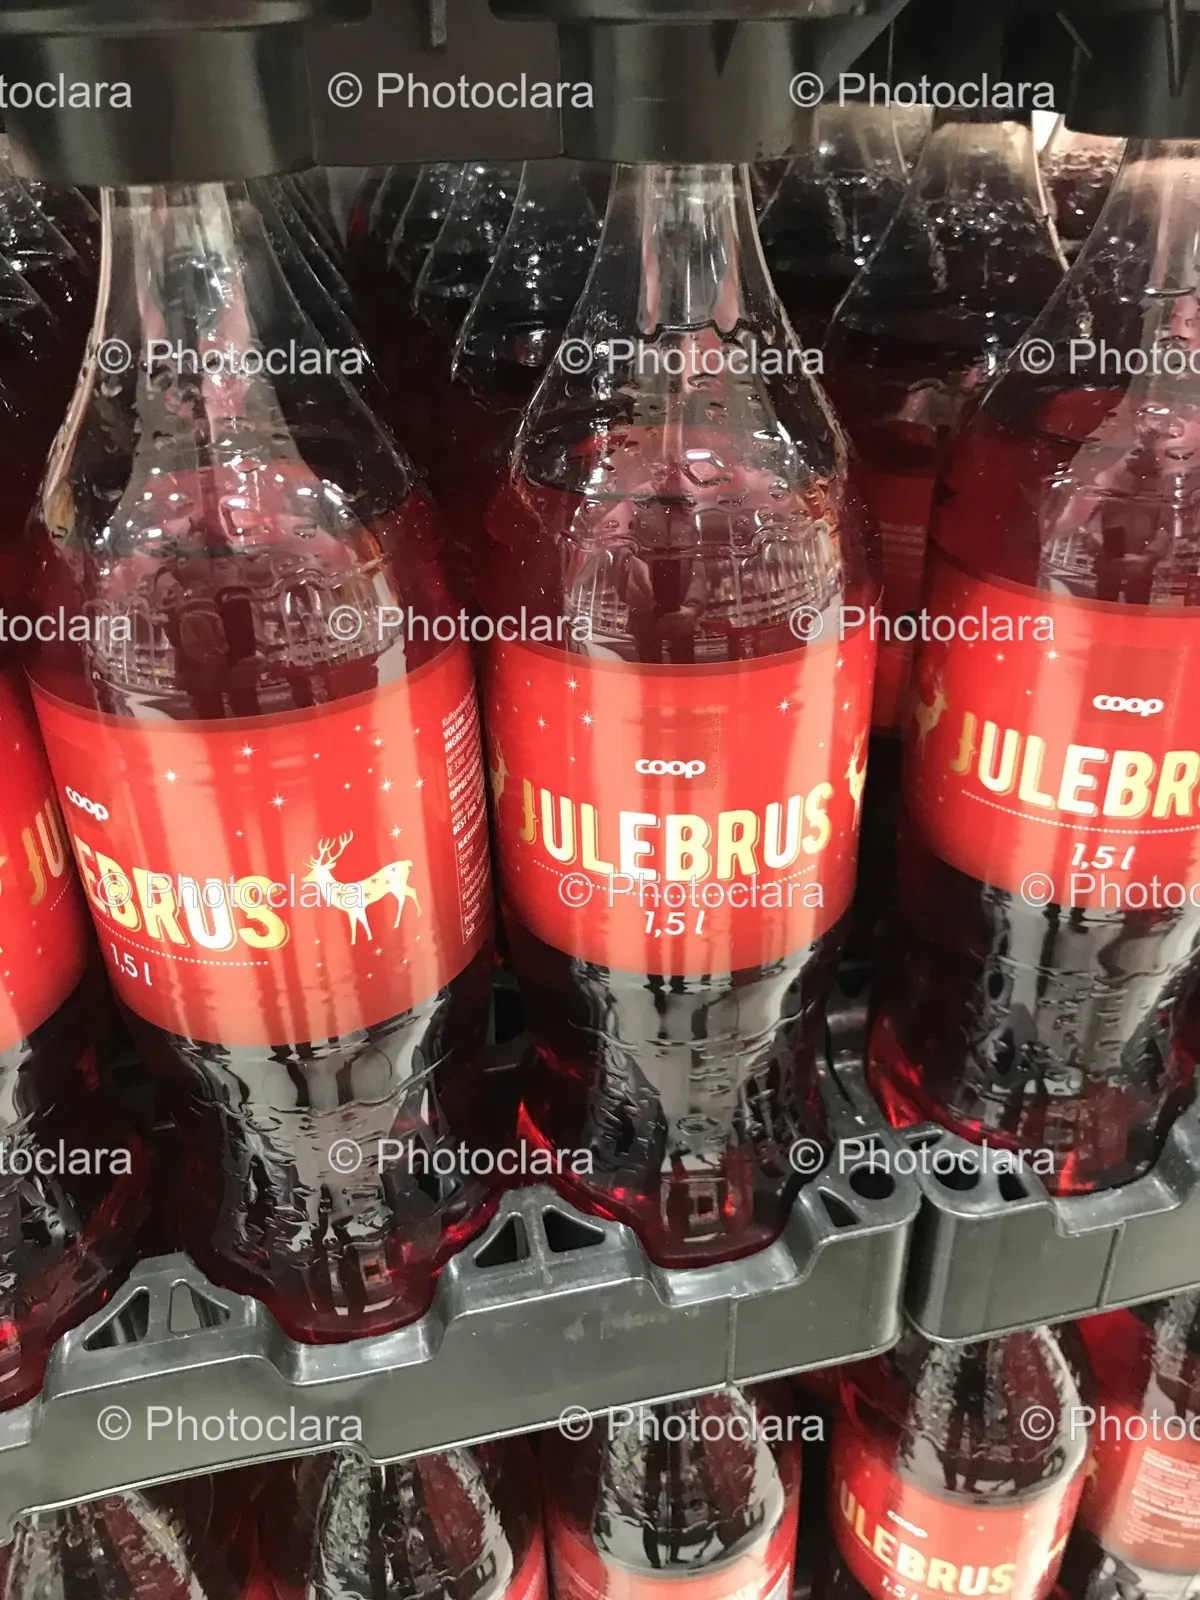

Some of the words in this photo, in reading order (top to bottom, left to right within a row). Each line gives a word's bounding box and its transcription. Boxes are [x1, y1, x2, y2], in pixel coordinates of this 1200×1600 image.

[1093, 695, 1164, 717] coop
[635, 758, 706, 779] coop
[951, 711, 1200, 820] JULEBR
[65, 786, 110, 821] coop
[519, 780, 834, 884] JULEBRUS
[1071, 843, 1118, 870] 1,5
[644, 911, 686, 938] 1,5
[110, 942, 139, 979] 1,5
